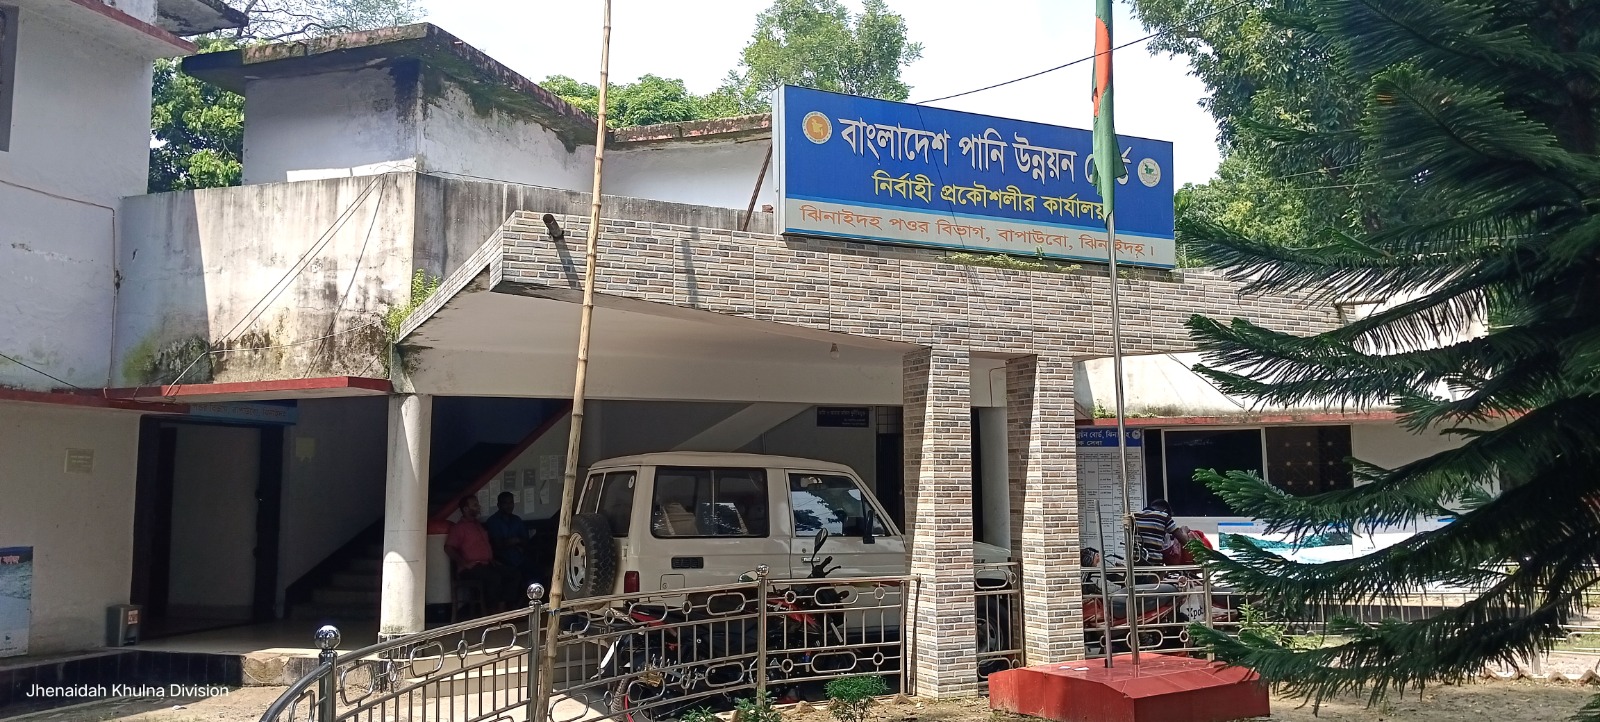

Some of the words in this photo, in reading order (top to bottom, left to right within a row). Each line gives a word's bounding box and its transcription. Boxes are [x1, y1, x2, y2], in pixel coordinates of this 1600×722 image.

[838, 116, 951, 167] বাংলাদেশ
[959, 127, 1008, 175] পানি
[1012, 131, 1078, 185] উন্নয়ন
[871, 169, 936, 204] নির্বাহী
[940, 181, 1037, 213] প্রকৌশলীর
[1041, 193, 1105, 219] কার্যালয়
[800, 204, 882, 231] ঝিনাইদহ
[889, 218, 931, 234] পওর
[935, 219, 991, 242] বিভাগ,
[996, 228, 1073, 251] বাপাউবো,
